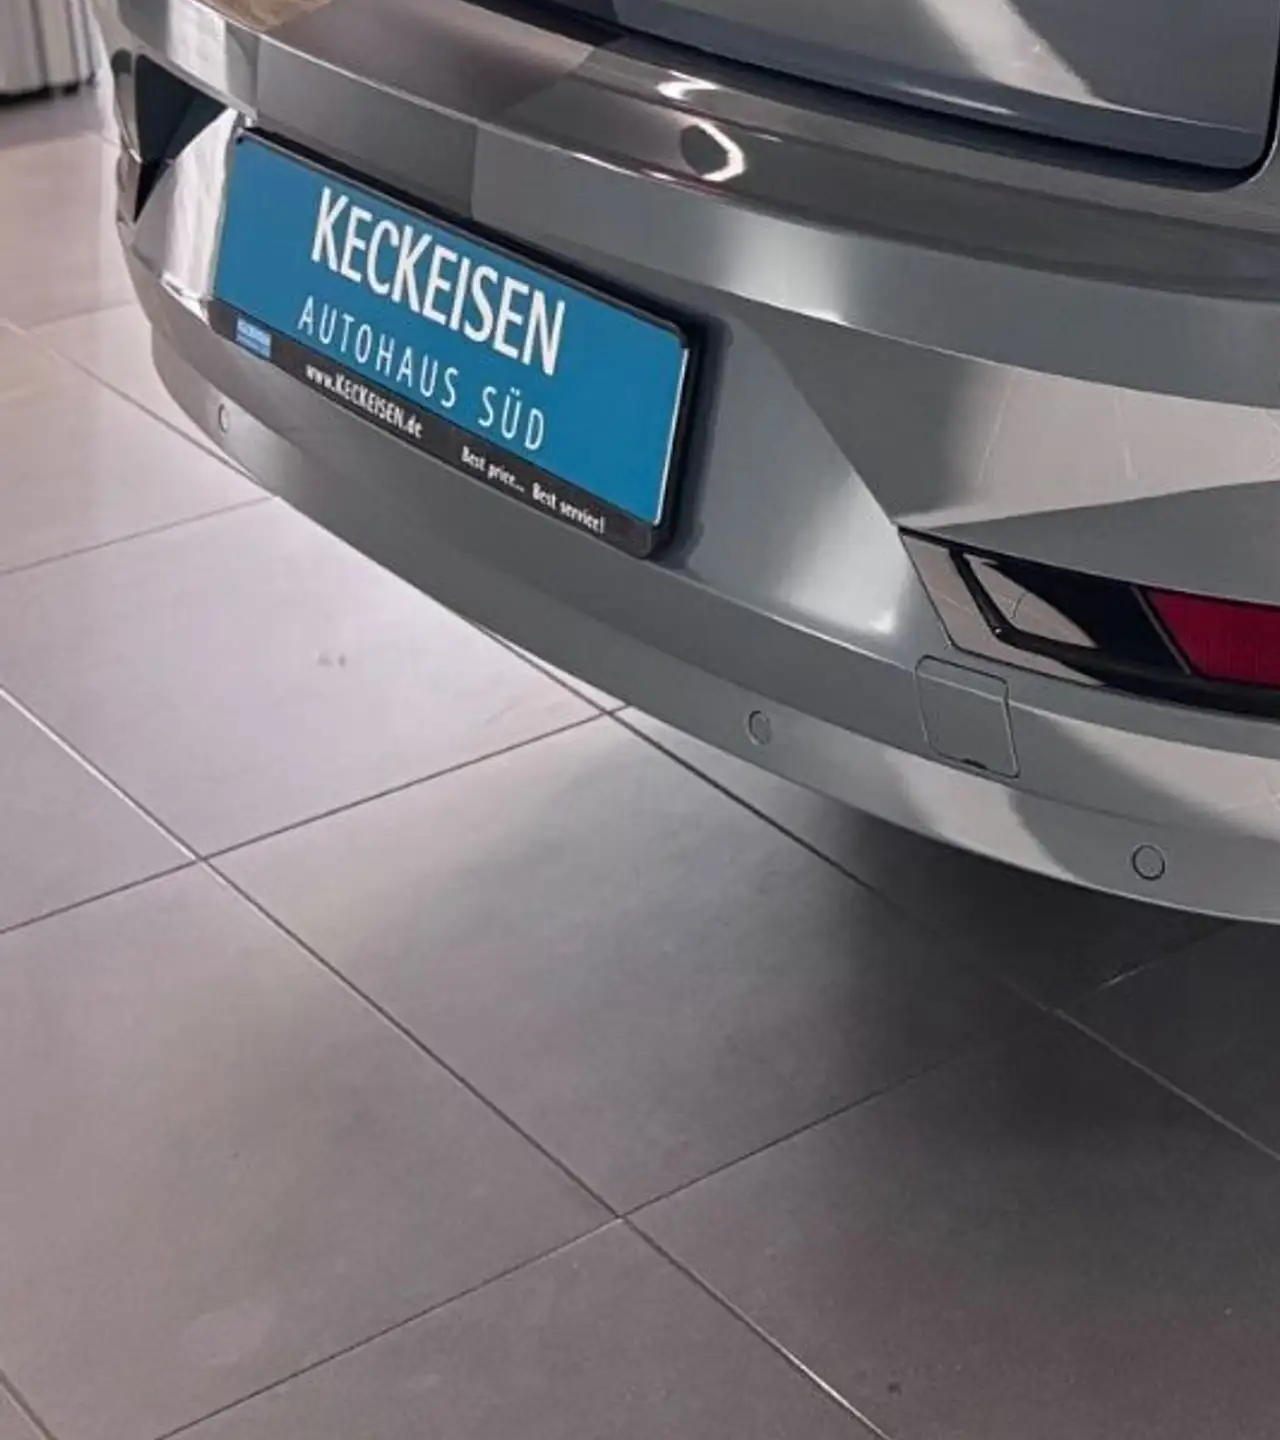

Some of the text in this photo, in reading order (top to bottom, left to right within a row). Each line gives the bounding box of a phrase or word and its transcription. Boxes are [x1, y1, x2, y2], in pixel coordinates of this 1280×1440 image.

[311, 185, 566, 376] KECKEISEN
[297, 295, 460, 409] AUTOHAUS
[477, 385, 545, 451] SÜD
[305, 363, 423, 439] www.KECKEISEN.de
[461, 445, 486, 472] Best
[532, 482, 557, 510] Best
